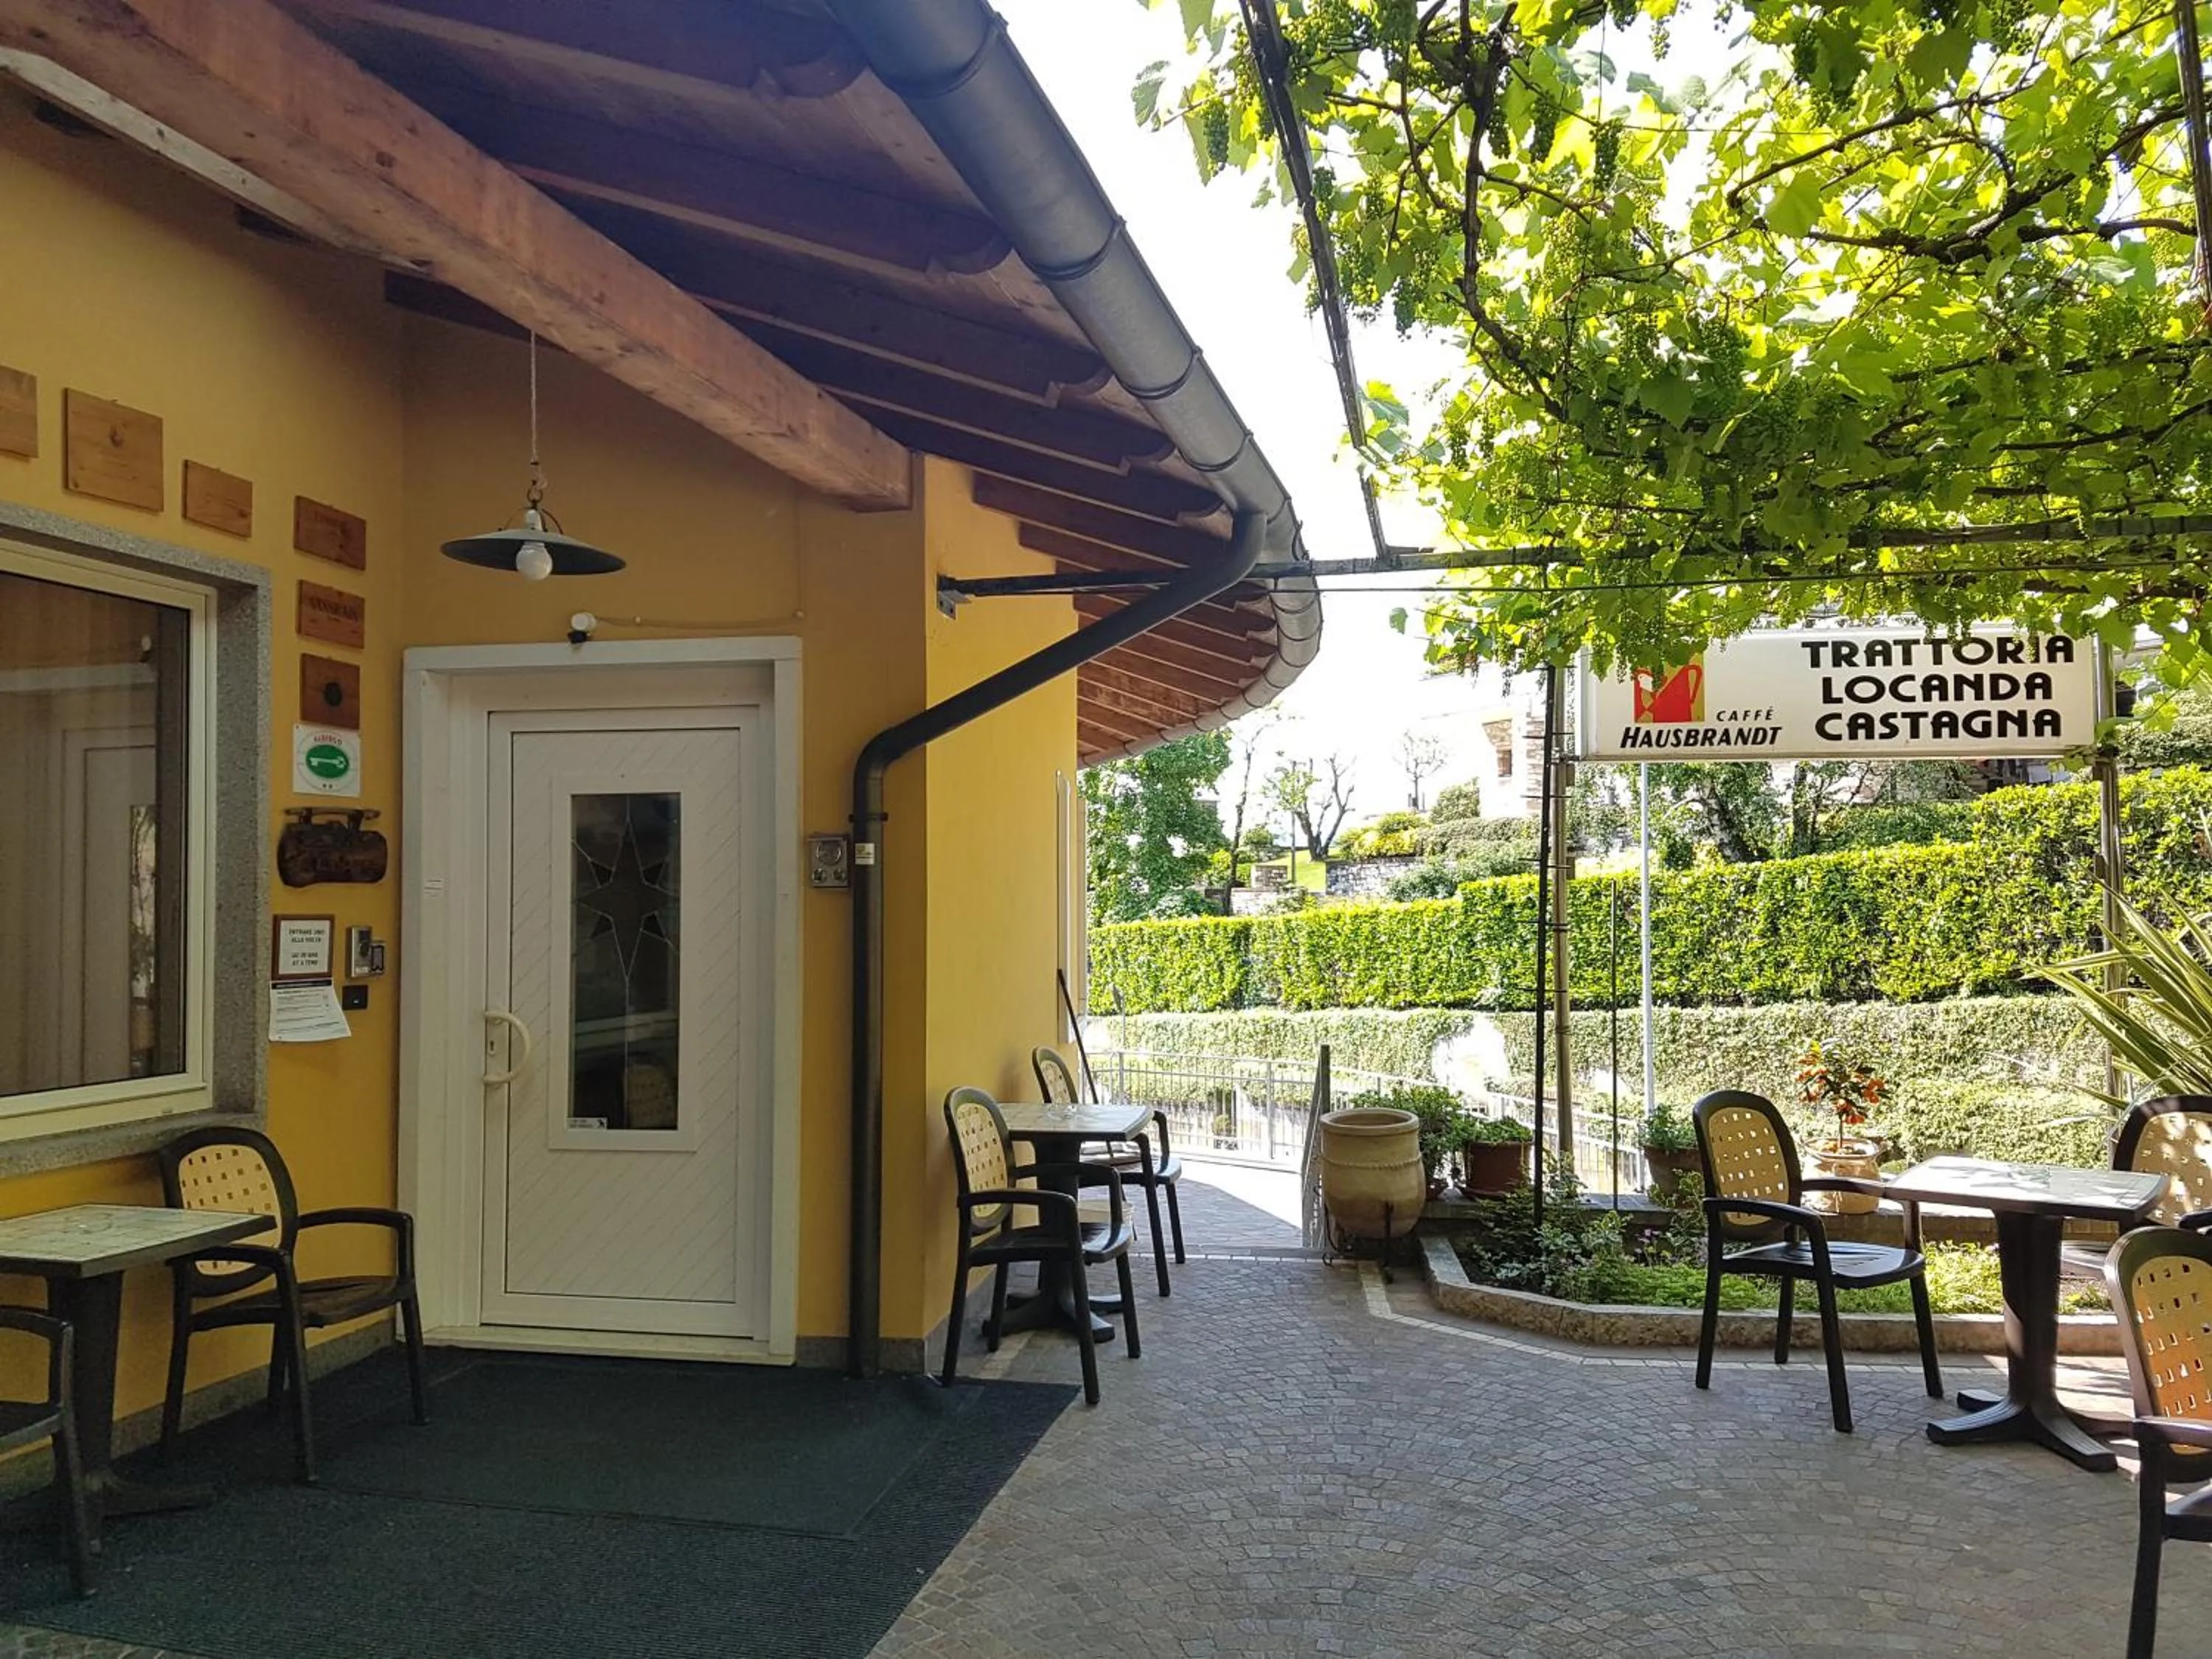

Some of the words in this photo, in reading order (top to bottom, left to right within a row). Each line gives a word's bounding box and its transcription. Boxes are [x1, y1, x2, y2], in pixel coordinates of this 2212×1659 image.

[1801, 635, 2075, 668] TRATTORIA
[1821, 672, 2053, 703] LOCANDA
[1716, 706, 1775, 722] CAFFÉ
[1815, 709, 2062, 740] CASTAGNA
[1620, 726, 1783, 748] HAUSBRANDT
